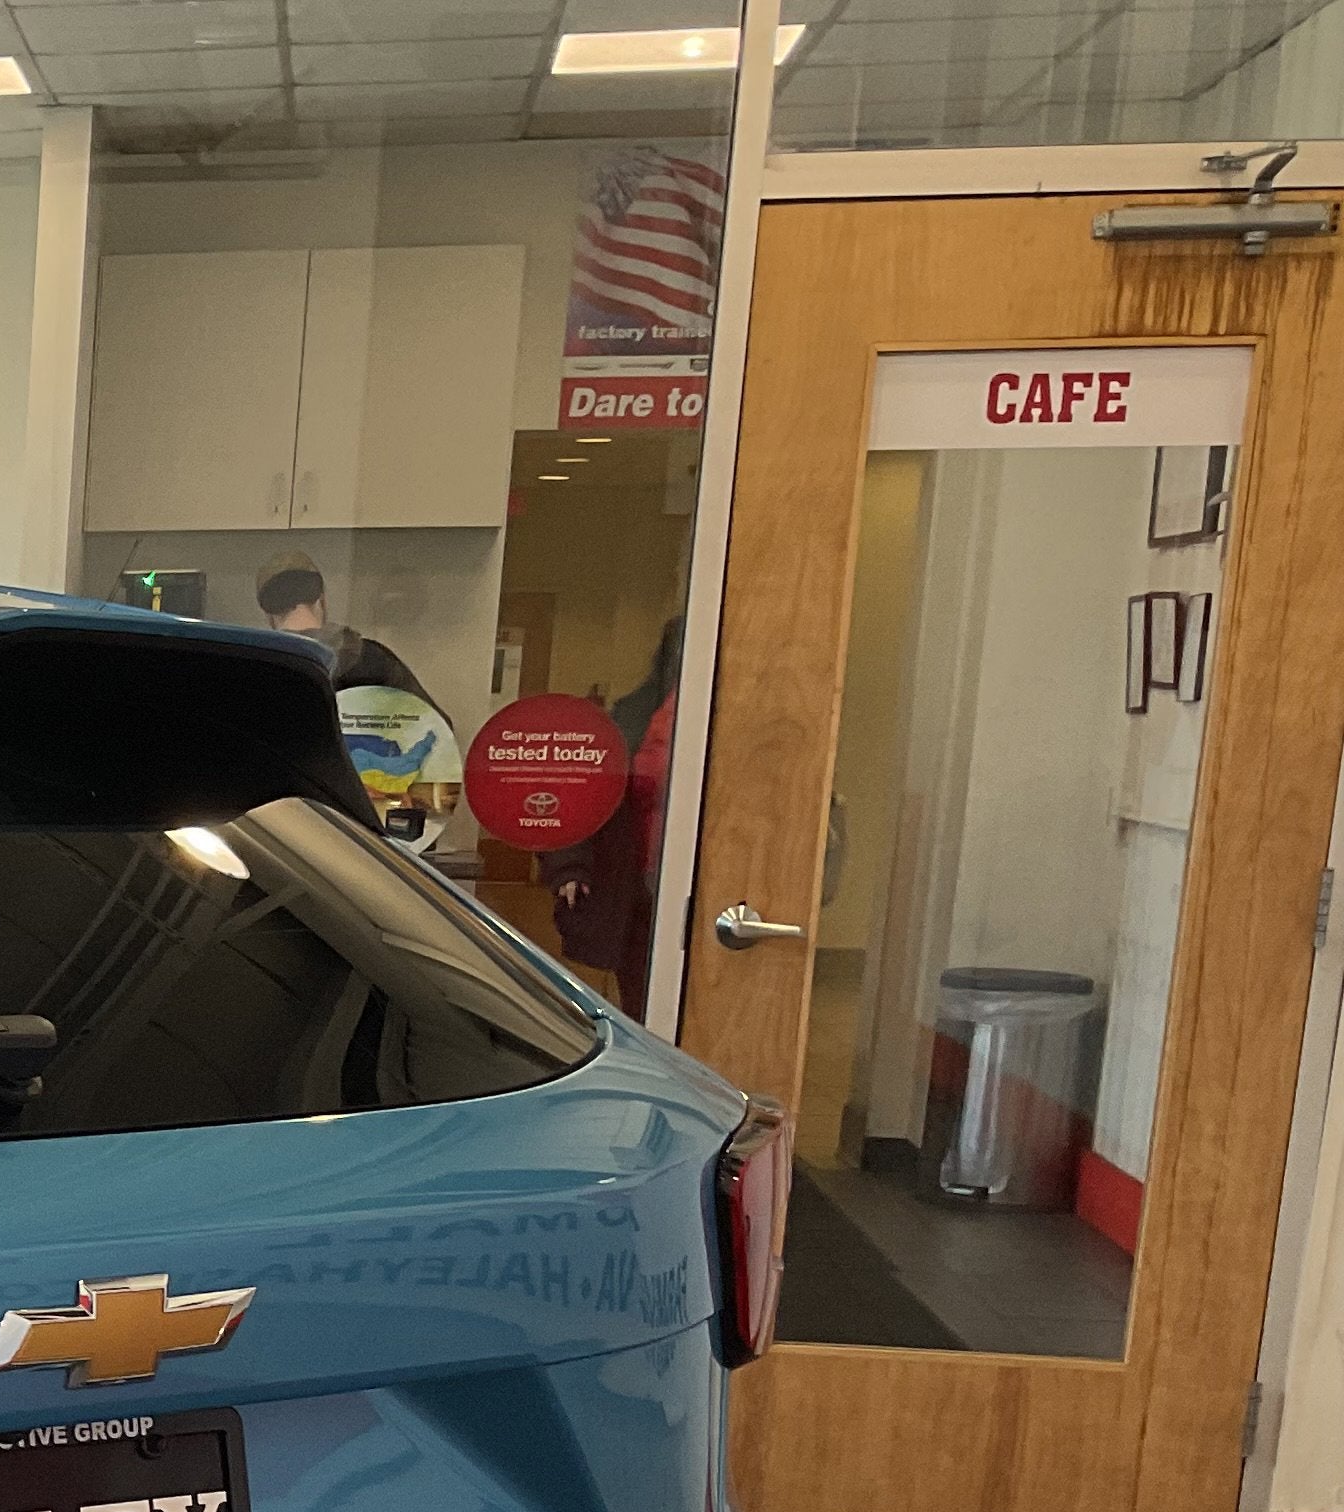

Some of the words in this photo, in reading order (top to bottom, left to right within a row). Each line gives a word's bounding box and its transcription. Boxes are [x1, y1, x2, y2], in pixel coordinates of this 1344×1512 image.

[577, 325, 646, 342] factory
[568, 387, 654, 418] Dare
[666, 387, 703, 417] to
[986, 371, 1131, 425] CAFE
[501, 730, 523, 741] Get
[525, 732, 552, 743] your
[553, 731, 596, 744] battery
[487, 745, 548, 761] tested
[553, 745, 608, 765] today
[518, 817, 561, 828] TOYOTA
[73, 1415, 155, 1443] GROUP
